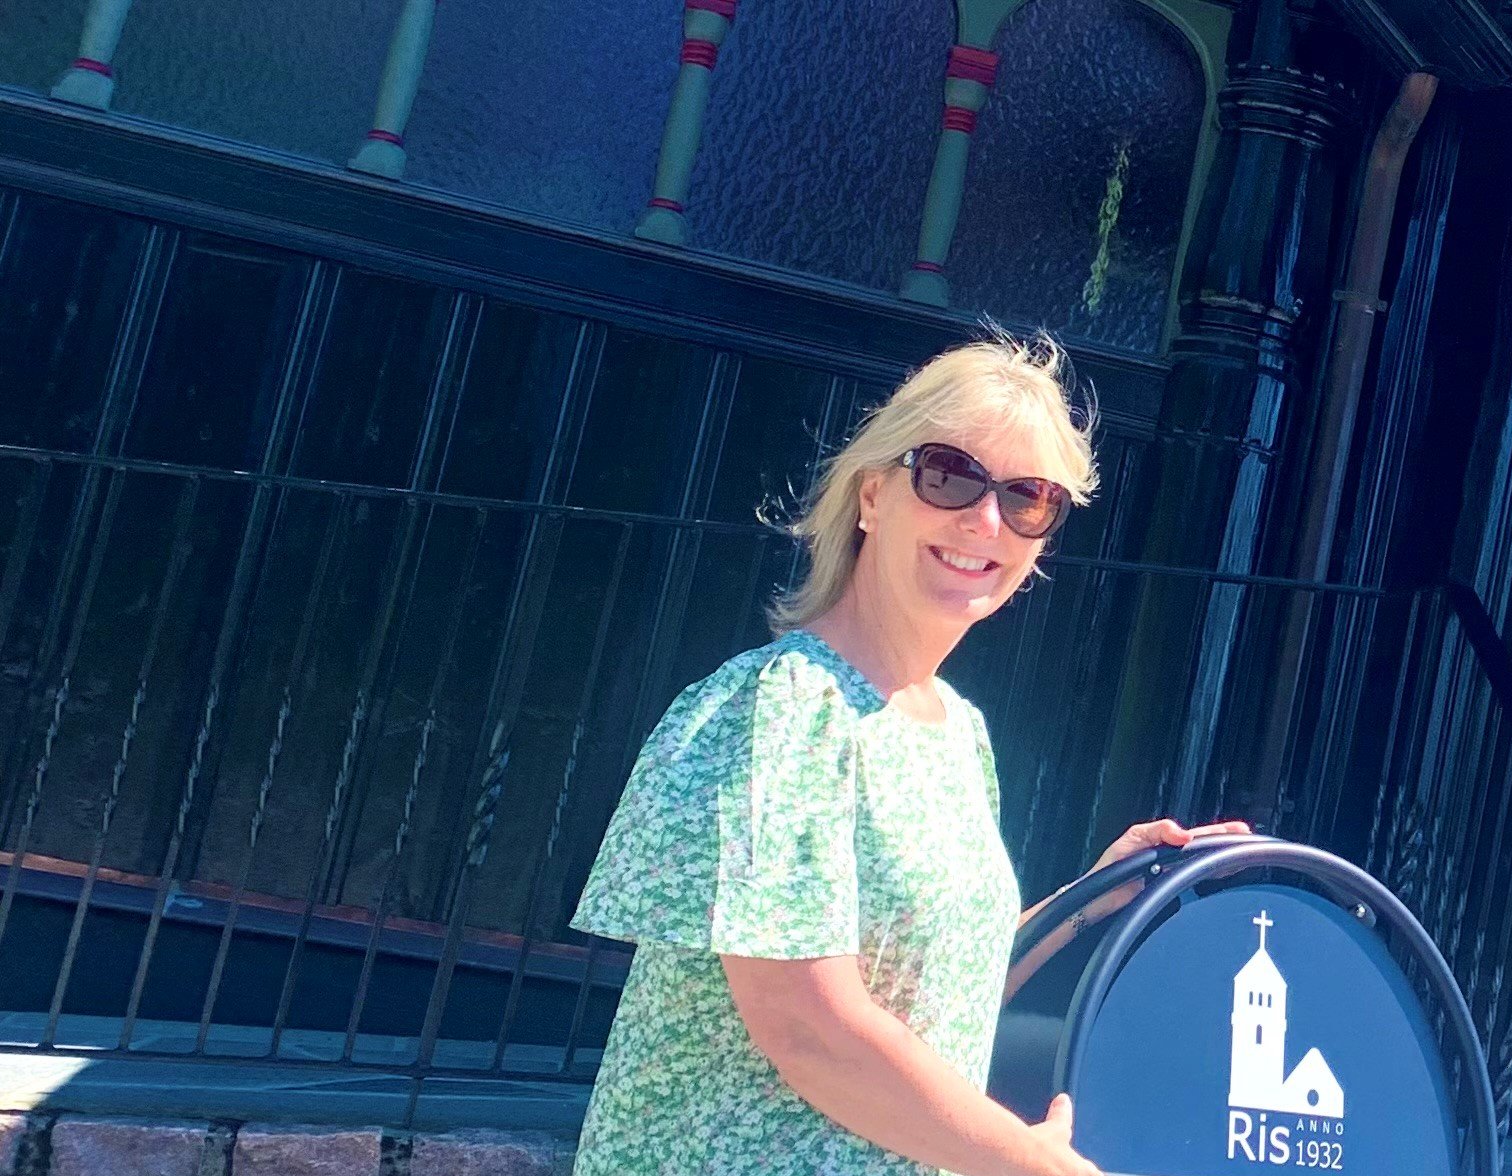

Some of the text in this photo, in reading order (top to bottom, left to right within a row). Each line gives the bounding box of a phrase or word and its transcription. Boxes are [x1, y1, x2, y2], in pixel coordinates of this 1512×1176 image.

[1227, 1110, 1291, 1164] Ris
[1296, 1118, 1344, 1136] ANNO
[1295, 1140, 1343, 1170] 1932
